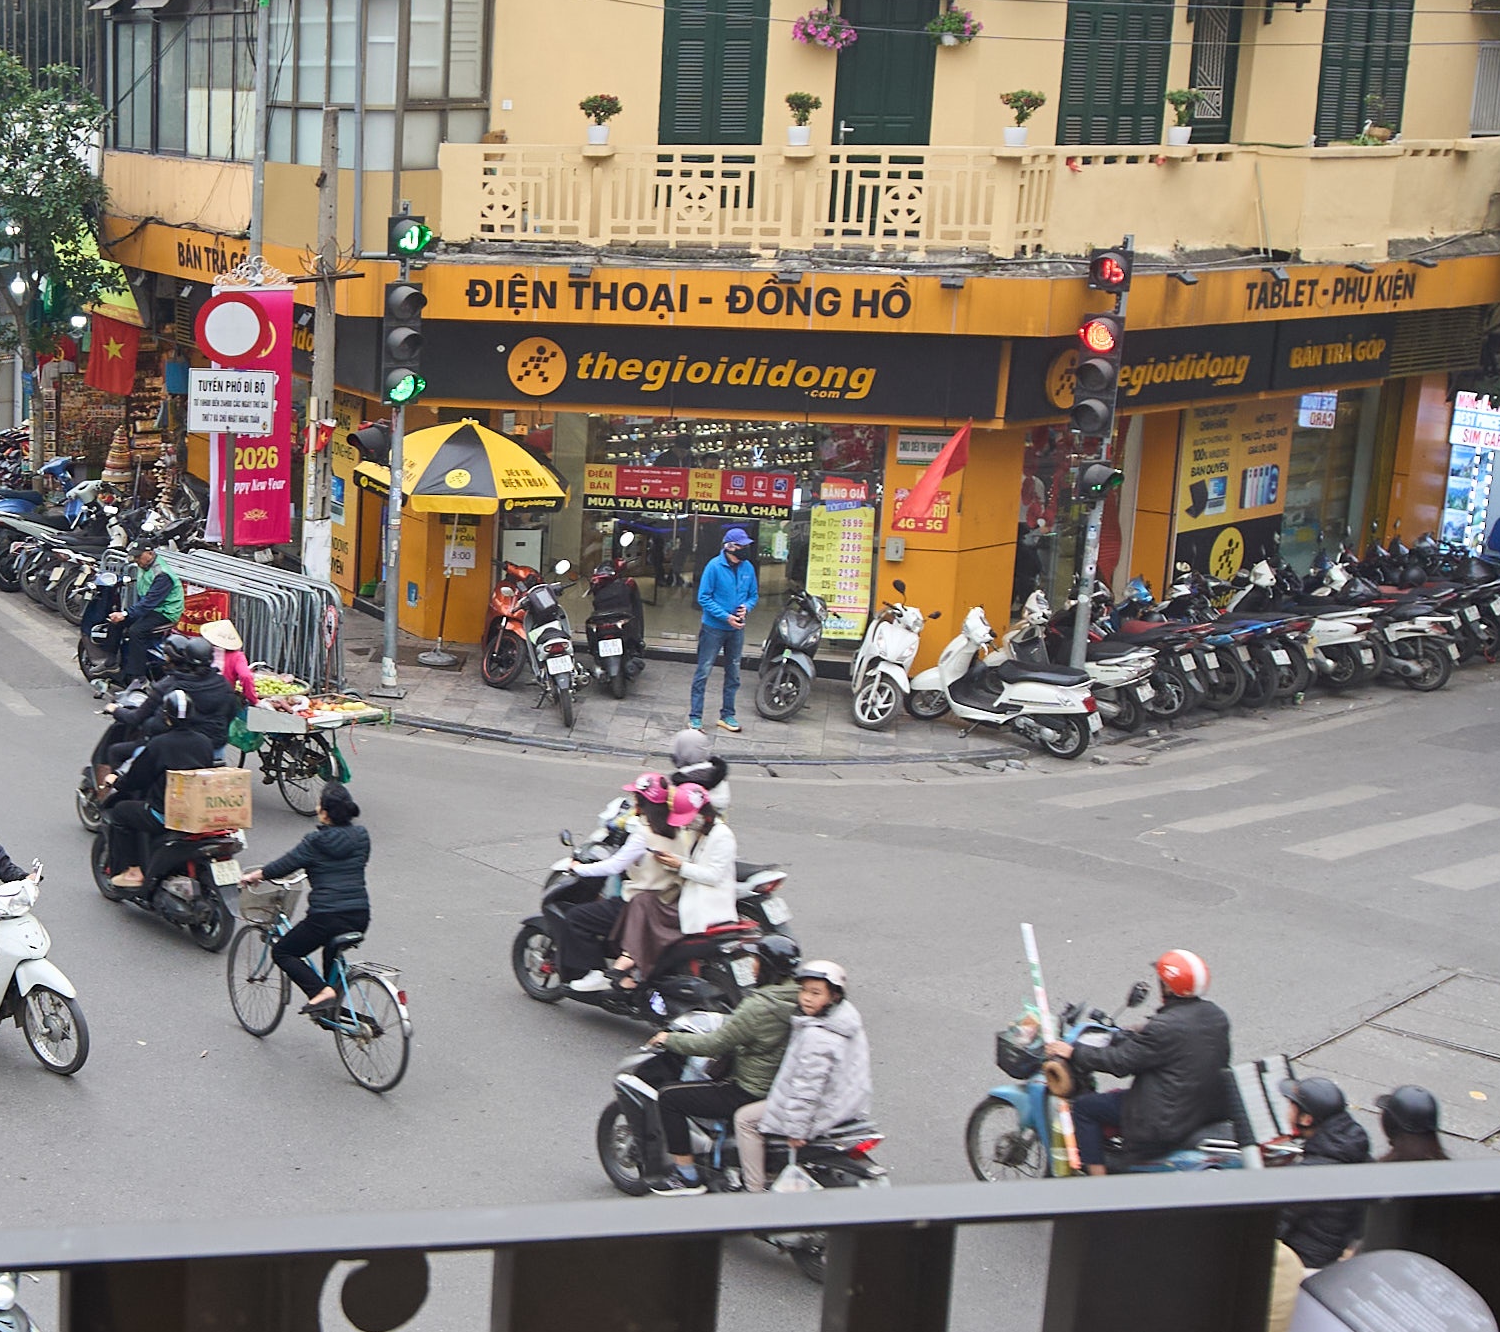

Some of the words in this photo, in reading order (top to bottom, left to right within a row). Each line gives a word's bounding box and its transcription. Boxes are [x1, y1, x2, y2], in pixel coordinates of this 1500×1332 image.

[177, 234, 201, 267] BÁN
[204, 240, 227, 272] TRẢ
[466, 273, 557, 316] ĐIỆN
[568, 280, 689, 319] THOẠI
[699, 296, 712, 304] -
[725, 273, 841, 317] ĐỒNG
[852, 275, 912, 319] HỒ
[1246, 278, 1320, 311] TABLET
[1331, 274, 1373, 310] PHỤ
[1374, 267, 1416, 308] KIỆN
[225, 377, 242, 393] PHỐ
[576, 351, 877, 400] thegioididong
[1118, 353, 1251, 396] egioididong
[1462, 428, 1481, 445] SIM
[234, 446, 279, 471] 2026
[587, 496, 616, 507] MUA
[618, 496, 644, 508] TRẢ
[722, 502, 749, 515] TRẢ
[751, 505, 789, 519] CHẬM
[898, 518, 916, 529] 4G
[925, 519, 944, 531] 5G
[205, 794, 245, 809] RINGO
